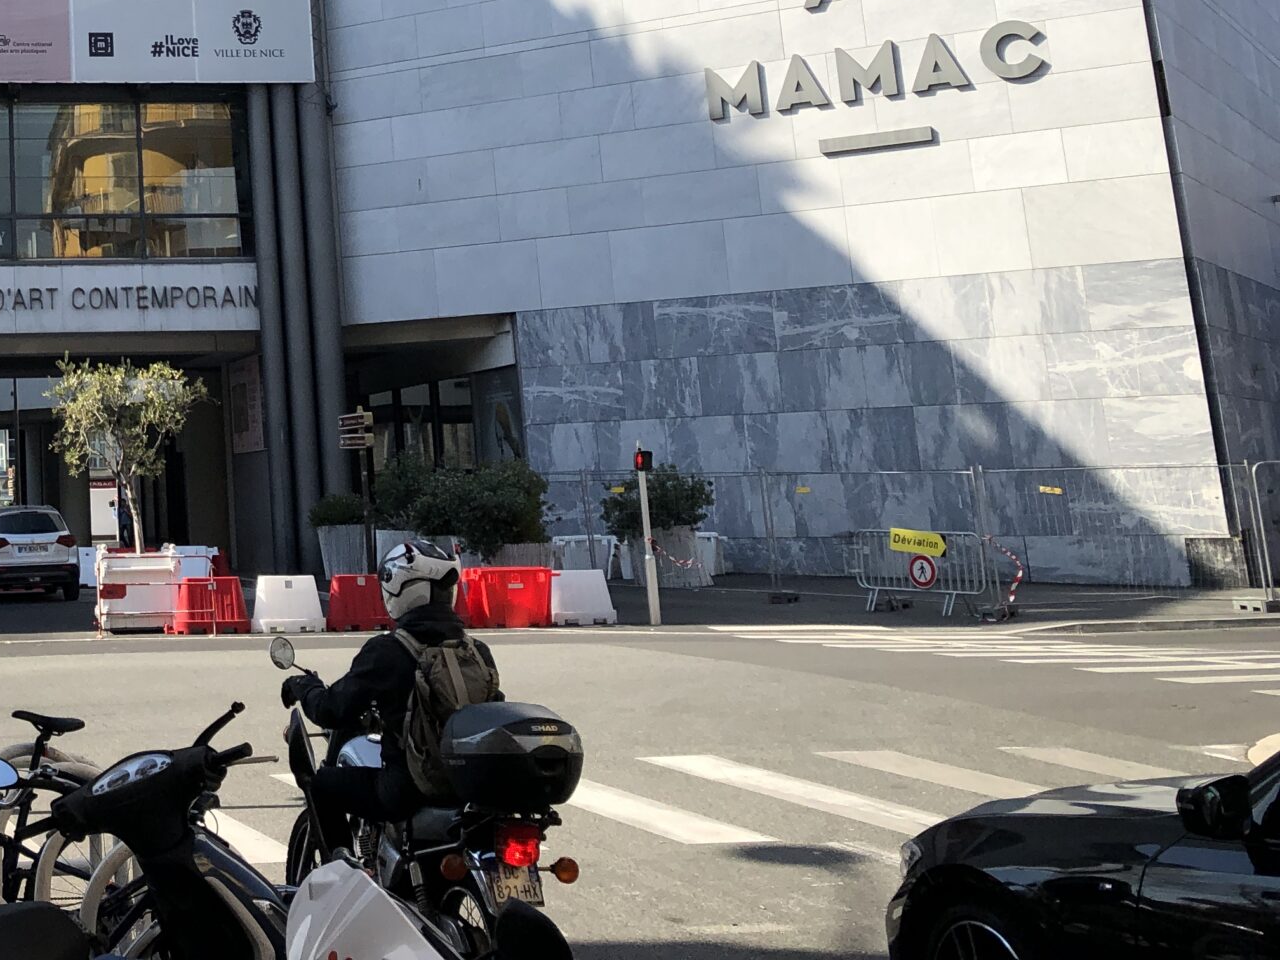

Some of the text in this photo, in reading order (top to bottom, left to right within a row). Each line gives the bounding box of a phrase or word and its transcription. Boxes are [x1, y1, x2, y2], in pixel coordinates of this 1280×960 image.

[214, 49, 285, 58] VILLE DE NICE
[704, 21, 1049, 121] MAMAC
[71, 285, 258, 310] CONTEMPORAIN
[893, 533, 939, 549] Déviation
[496, 884, 540, 900] 821-HX
